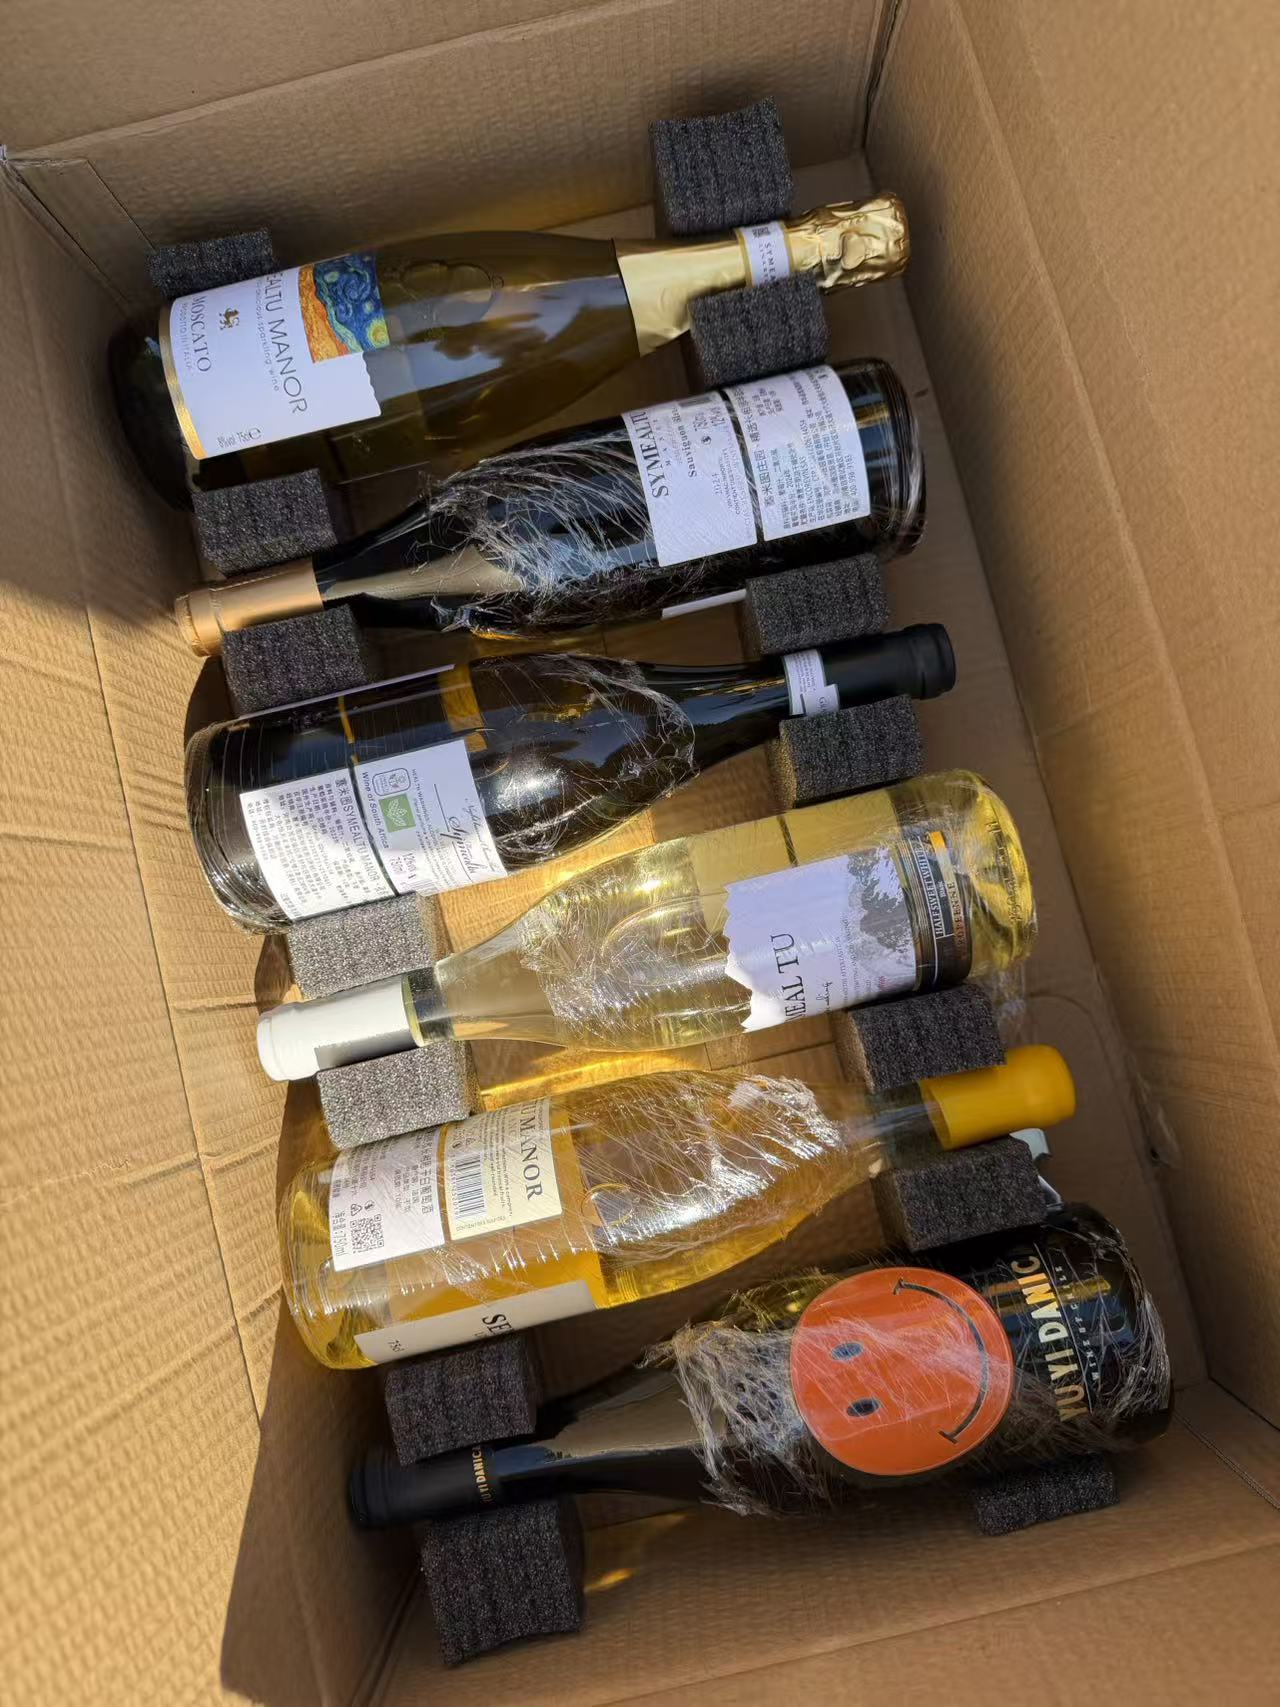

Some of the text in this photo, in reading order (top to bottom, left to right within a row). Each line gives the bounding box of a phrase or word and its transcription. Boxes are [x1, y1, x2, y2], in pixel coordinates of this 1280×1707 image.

[189, 293, 214, 373] MOSCATO
[256, 321, 274, 366] sparkling
[268, 368, 281, 393] wine
[265, 317, 309, 415] MANOR
[675, 424, 698, 478] Sauvignon
[359, 770, 373, 792] Wine
[366, 792, 376, 803] of
[368, 801, 383, 827] South
[376, 826, 390, 850] Africa
[768, 929, 800, 974] TU
[518, 1115, 544, 1201] MANOR
